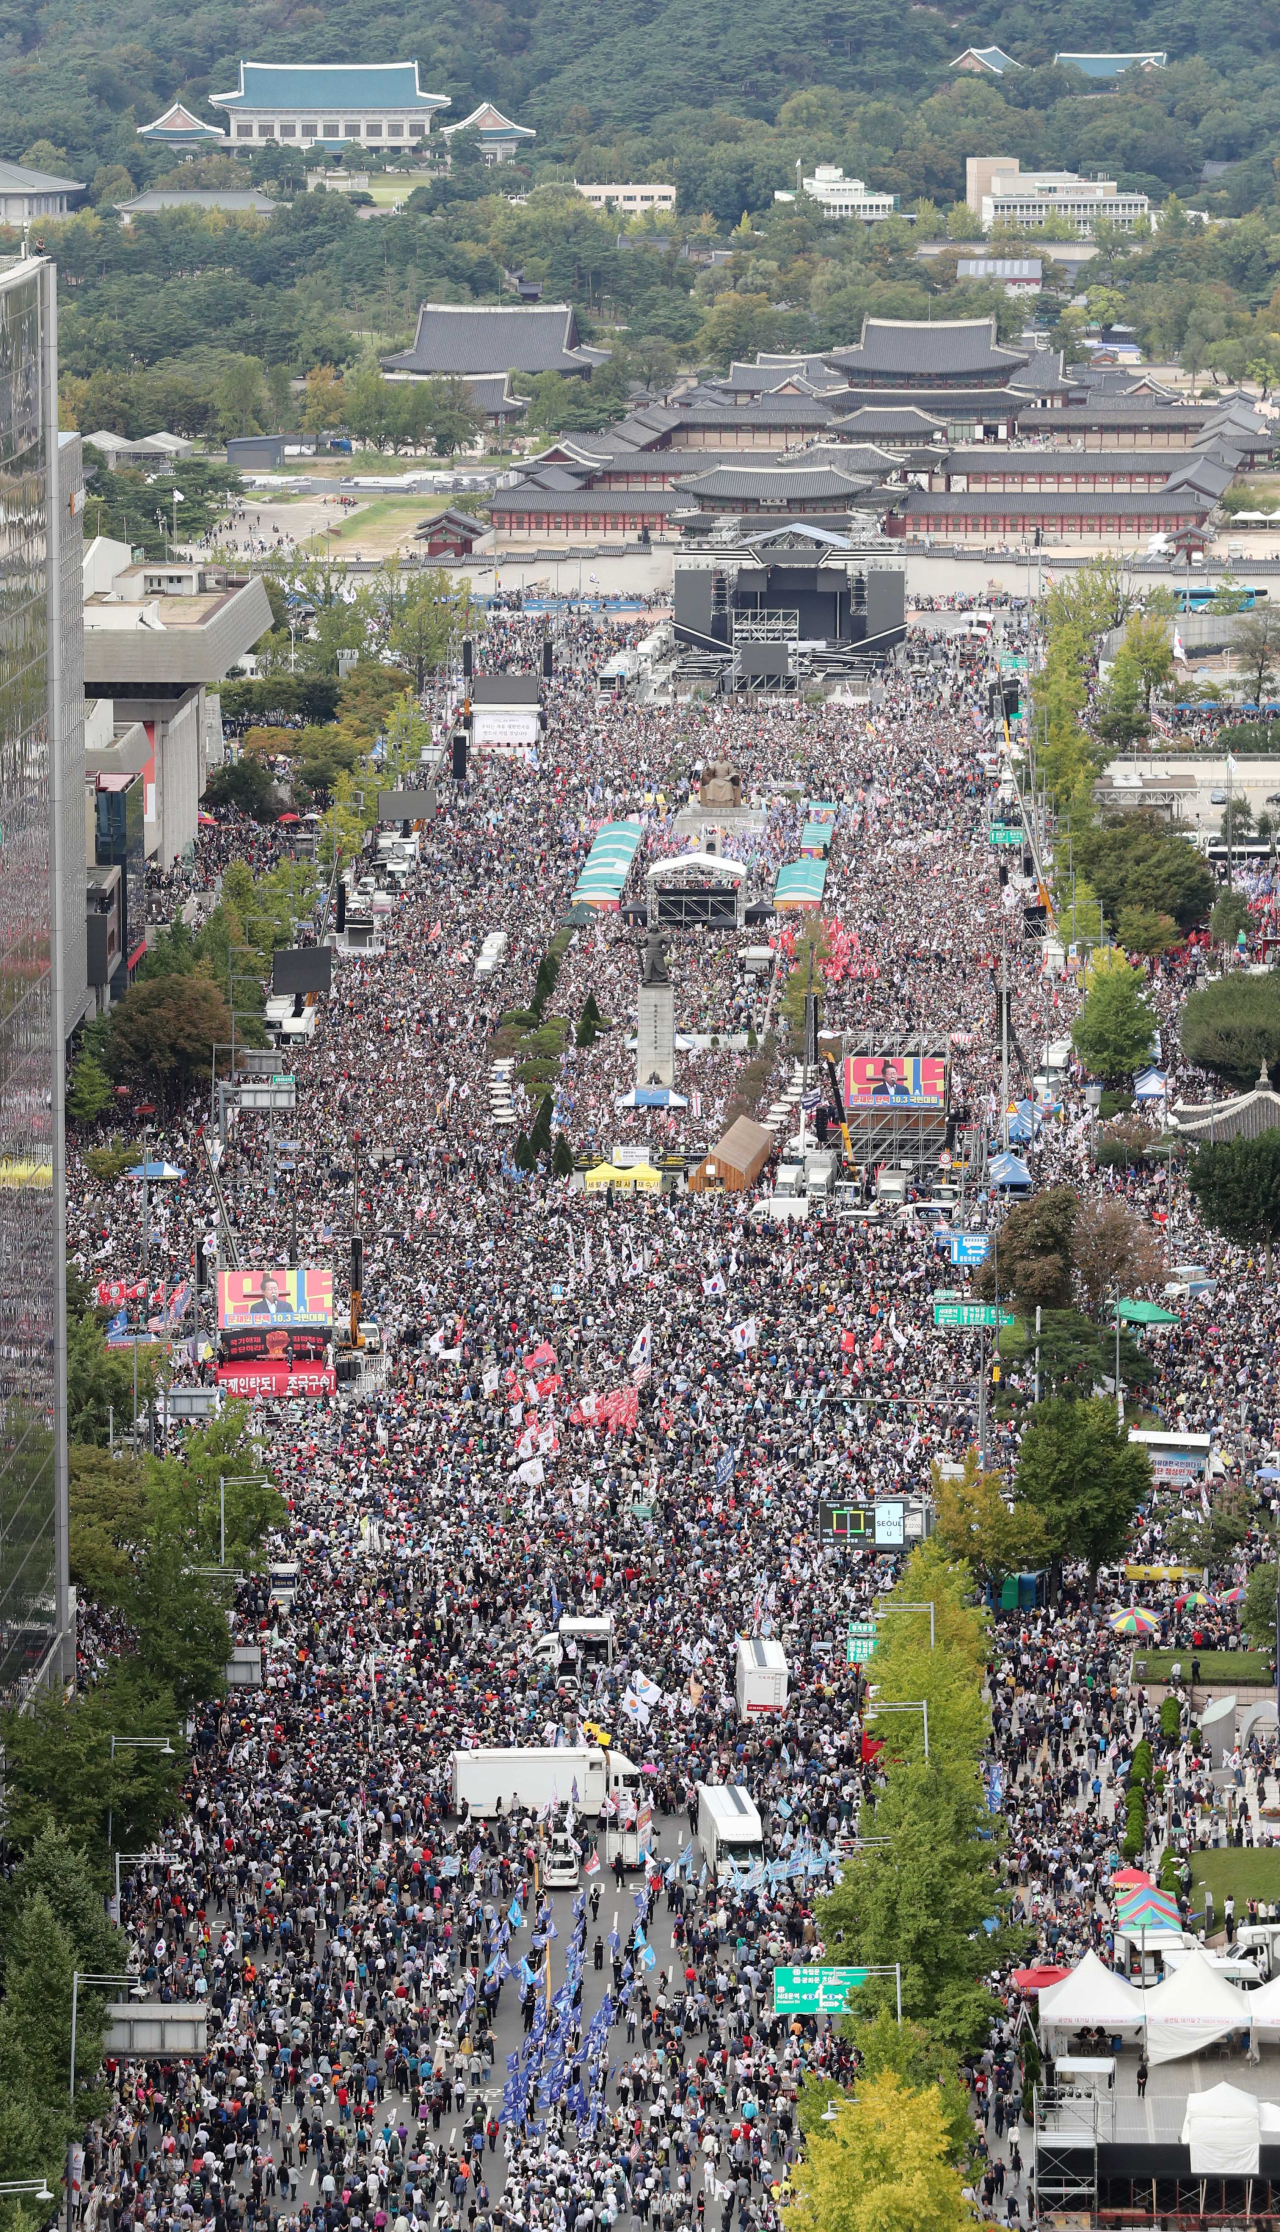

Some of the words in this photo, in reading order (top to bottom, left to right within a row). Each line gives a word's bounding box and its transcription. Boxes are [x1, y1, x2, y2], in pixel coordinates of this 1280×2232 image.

[852, 1096, 874, 1105] 문재인
[875, 1096, 890, 1105] 탄핵
[891, 1096, 908, 1104] 10.3
[909, 1096, 938, 1104] 국민대회
[228, 1314, 252, 1324] 문재인
[254, 1314, 271, 1324] 탄핵
[272, 1314, 292, 1322] 10.3
[293, 1314, 326, 1322] 국민대회
[287, 1375, 335, 1391] 조국구속!
